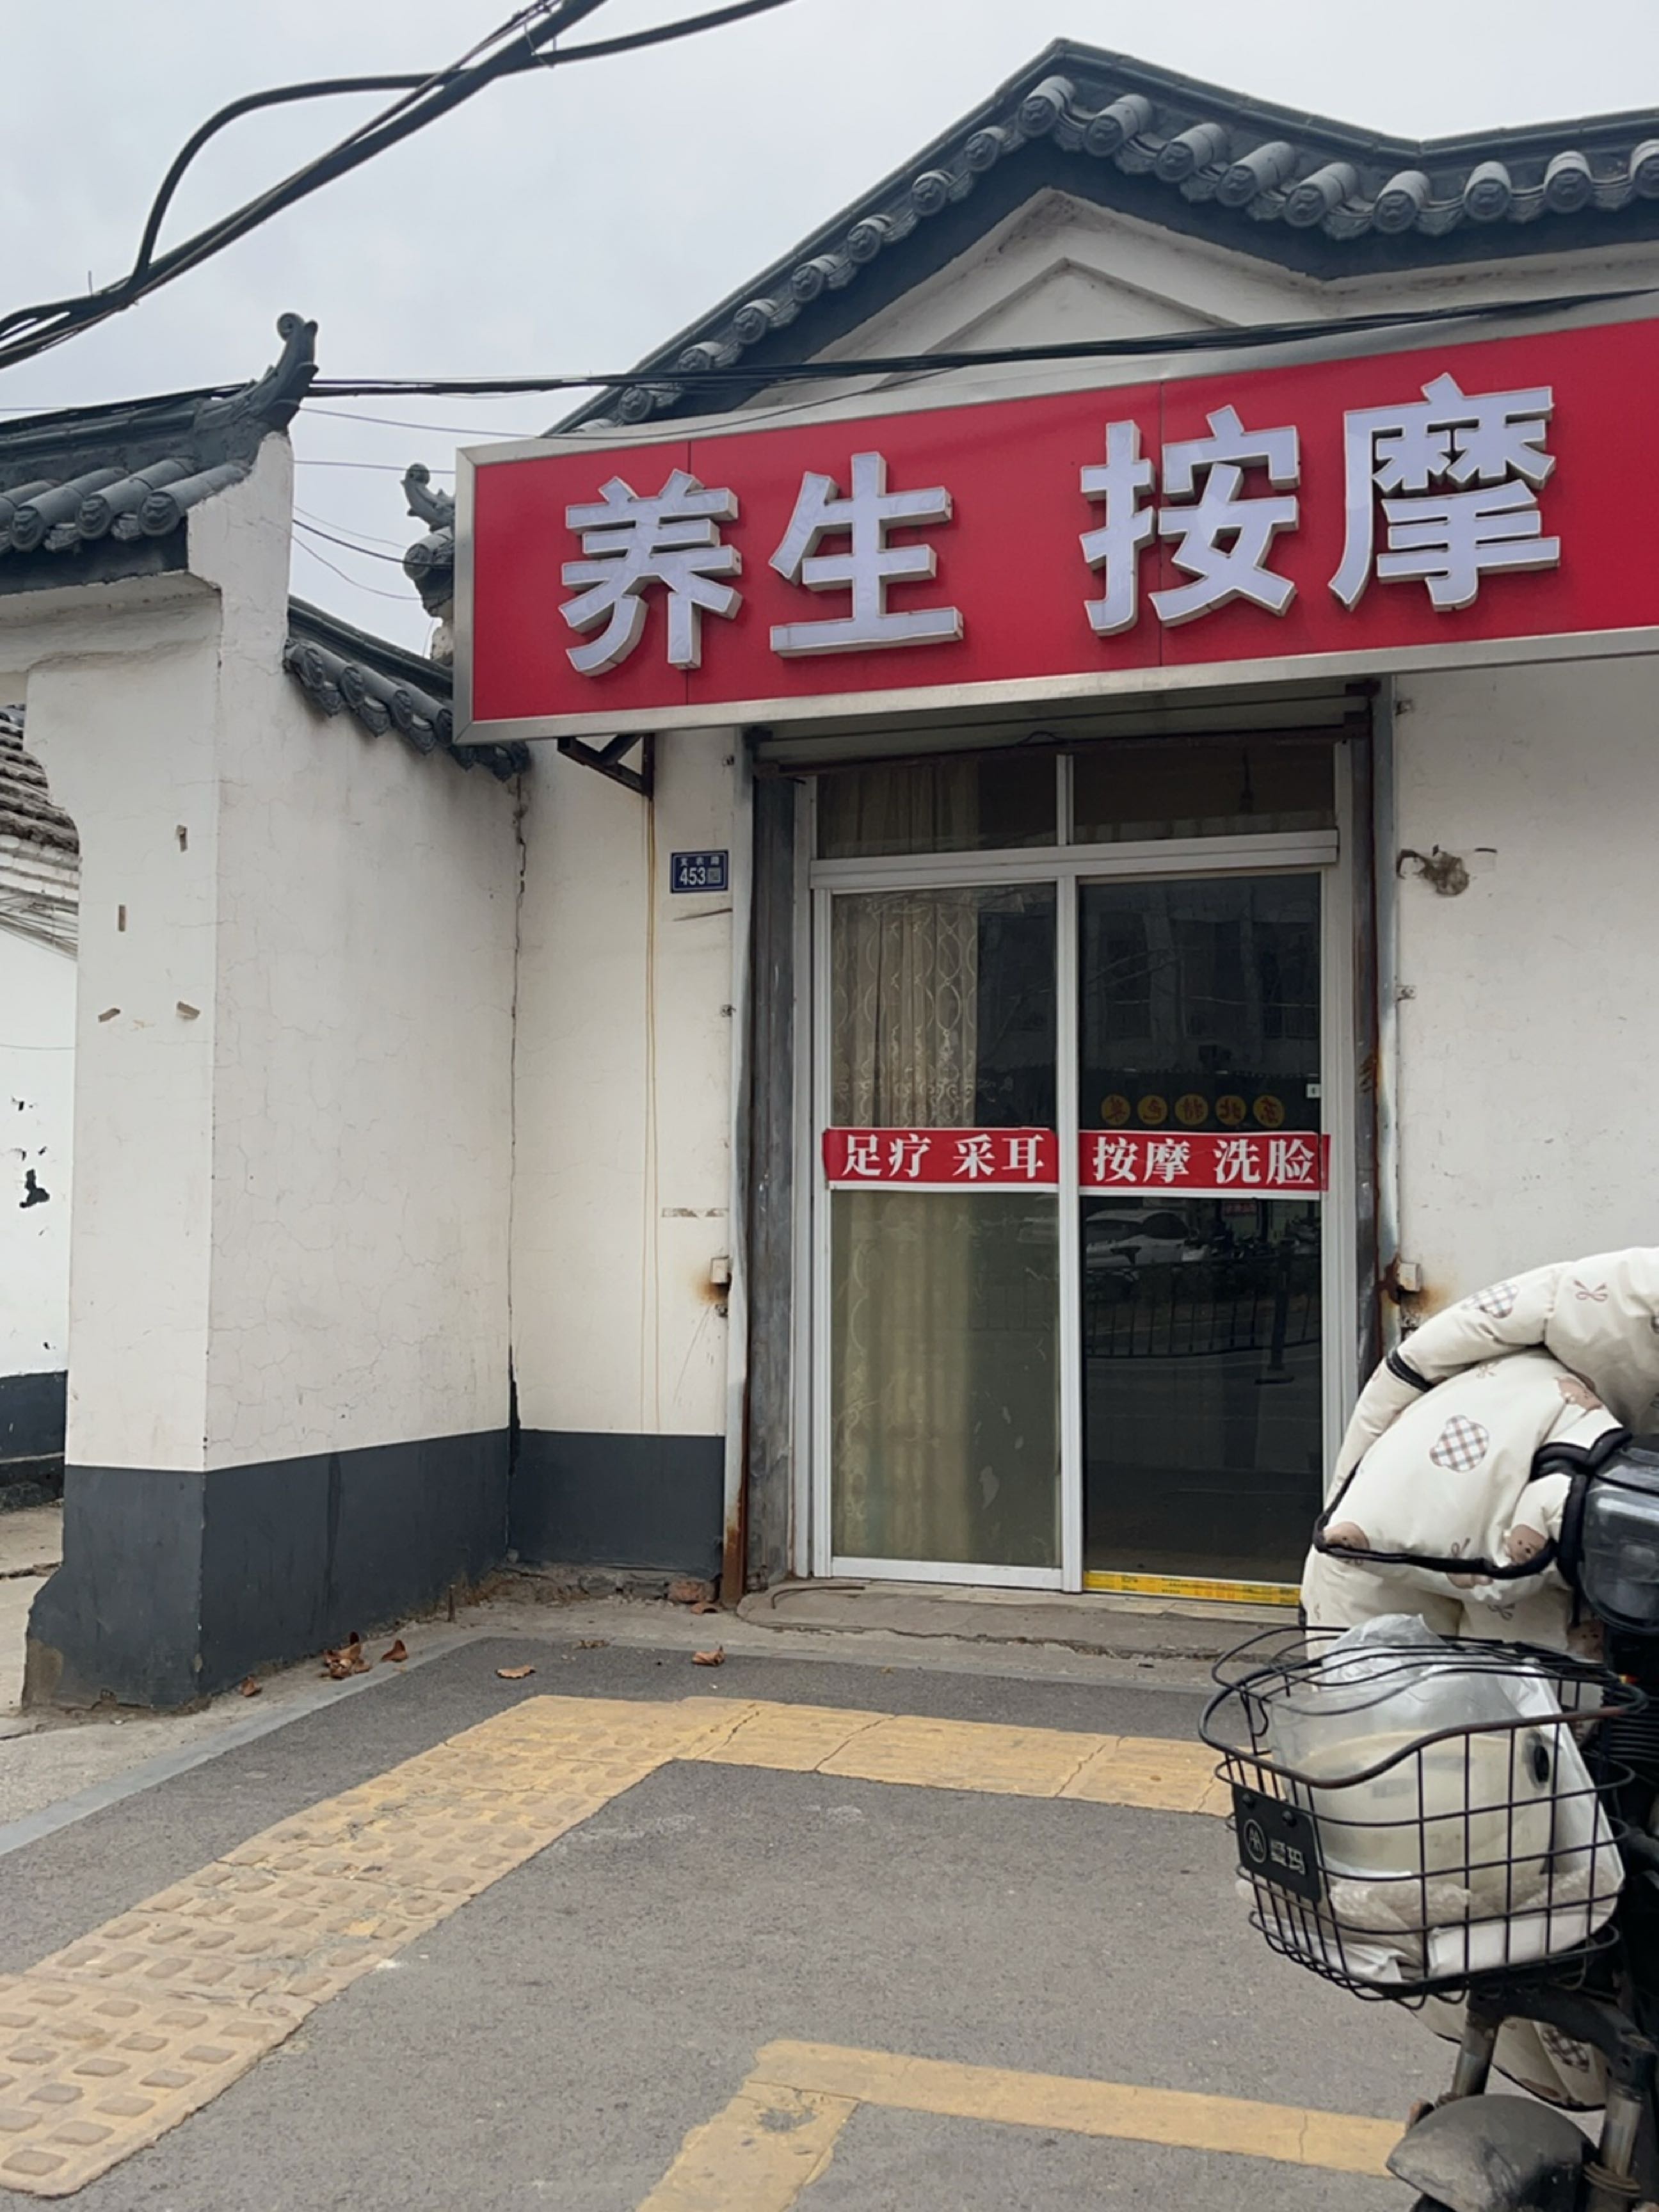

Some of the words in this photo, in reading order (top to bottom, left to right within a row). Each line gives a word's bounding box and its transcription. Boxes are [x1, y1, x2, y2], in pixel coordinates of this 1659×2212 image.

[559, 451, 964, 678] 养生
[1078, 371, 1562, 637] 按摩
[680, 866, 706, 886] 453
[841, 1133, 932, 1178] 足疗
[952, 1133, 1045, 1179] 采耳
[1092, 1135, 1192, 1183] 按摩
[1212, 1137, 1316, 1185] 洗脸
